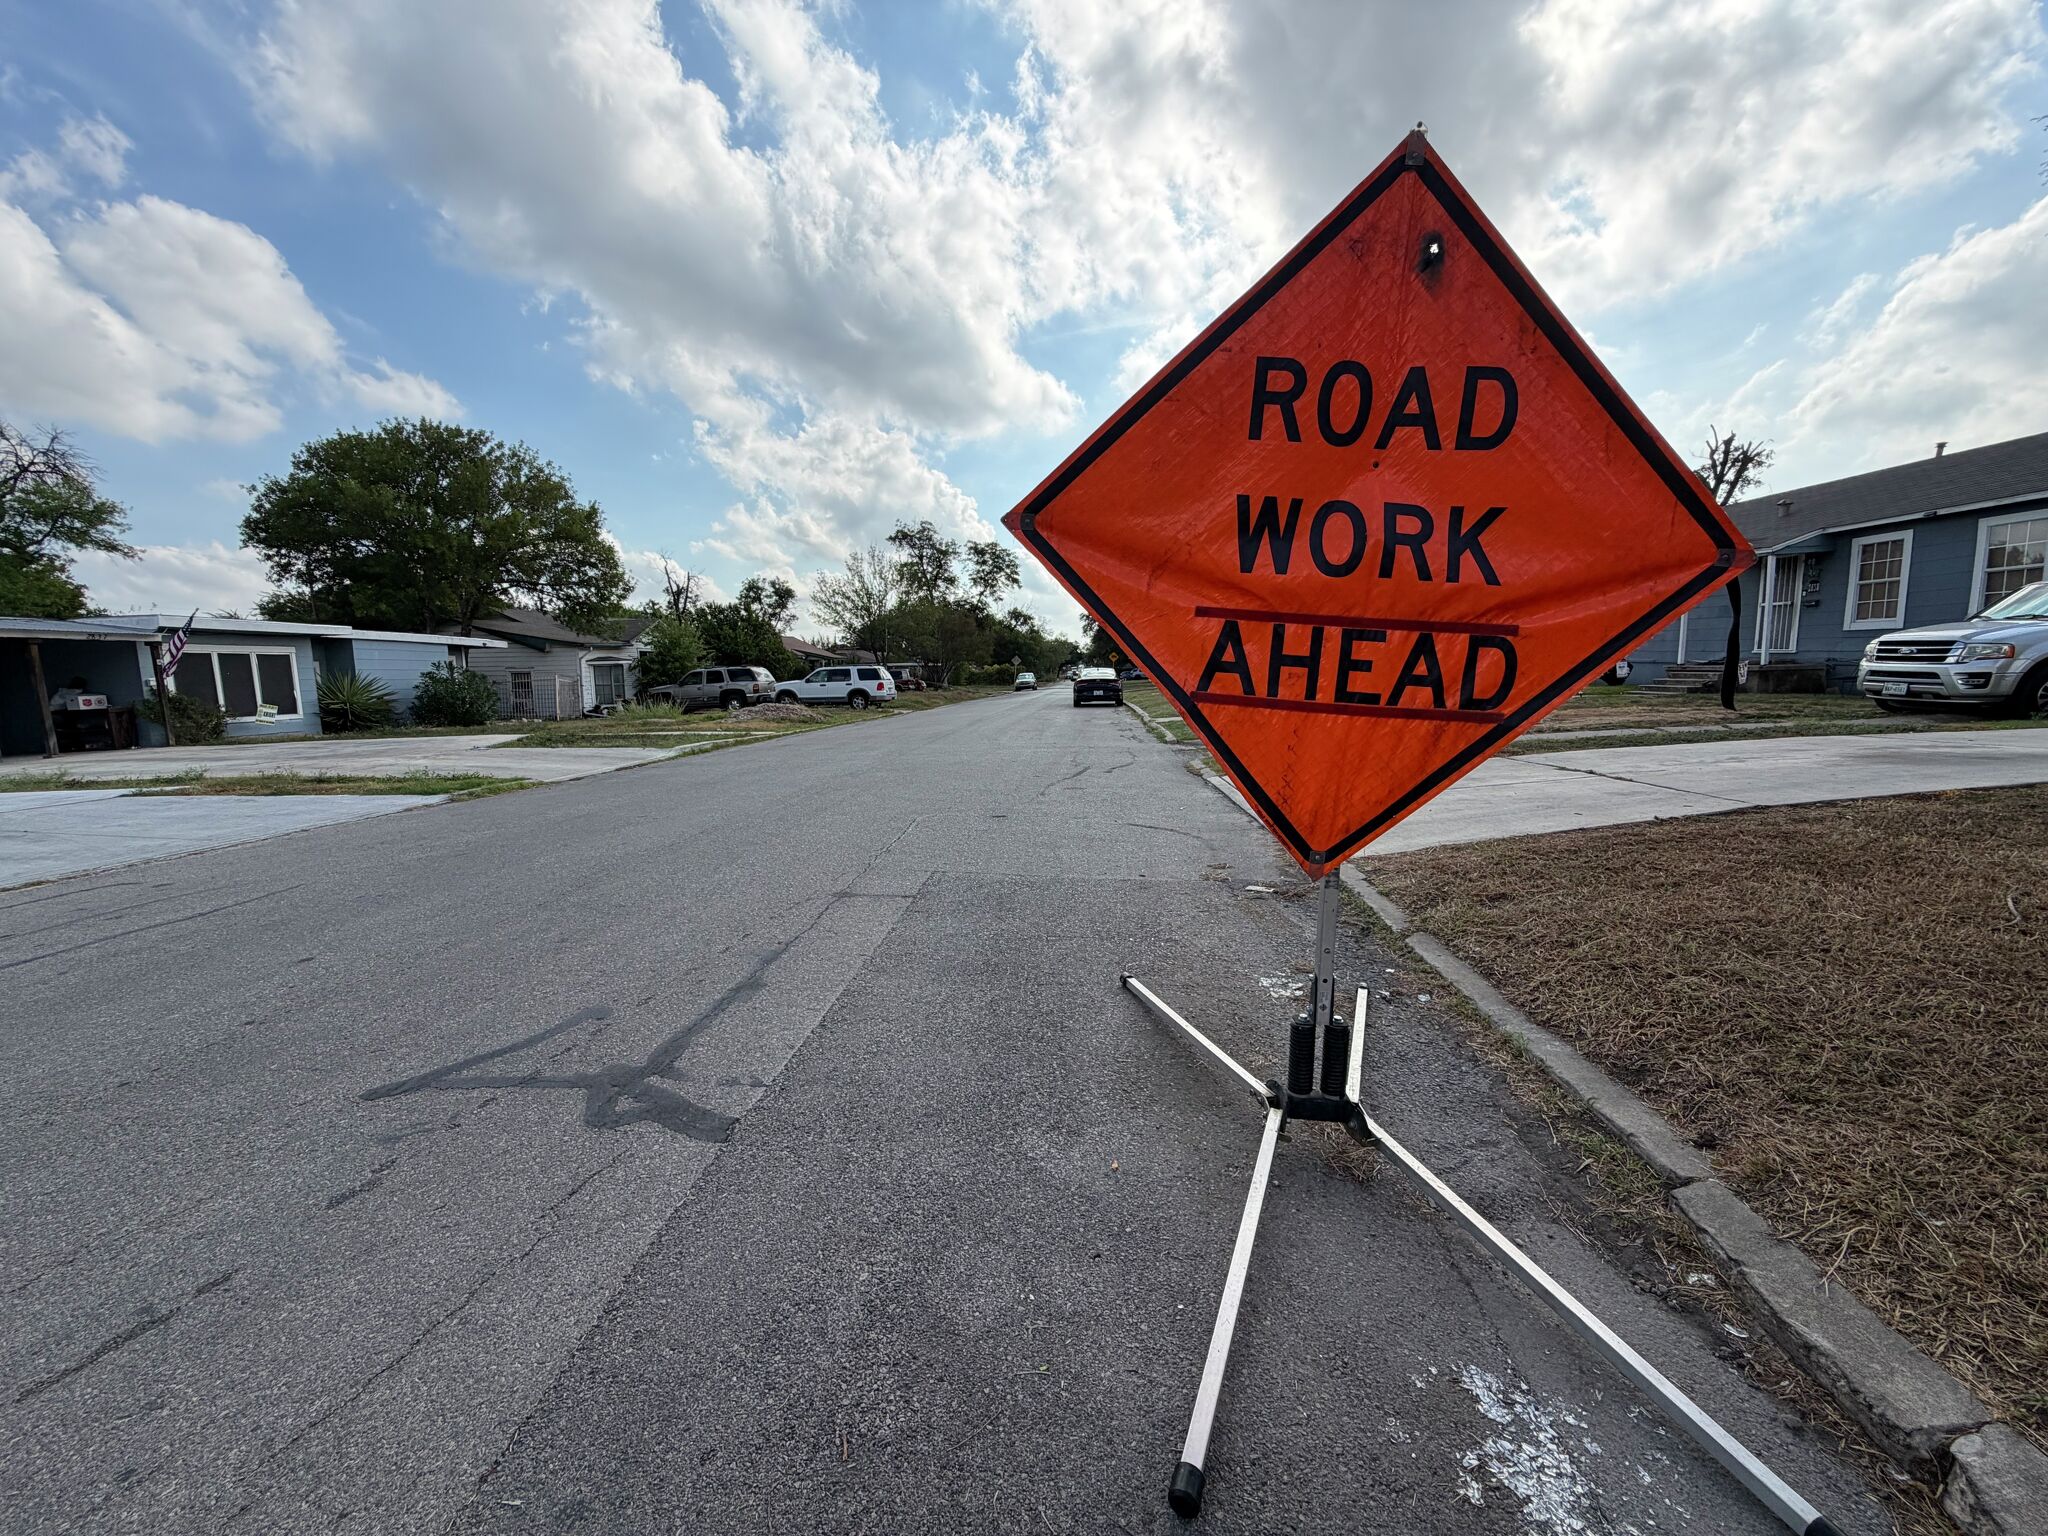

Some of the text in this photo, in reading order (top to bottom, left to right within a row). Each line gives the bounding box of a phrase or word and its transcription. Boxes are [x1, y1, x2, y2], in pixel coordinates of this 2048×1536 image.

[1248, 356, 1519, 450] ROAD
[1237, 494, 1507, 586] WORK
[1199, 620, 1518, 711] AHEAD
